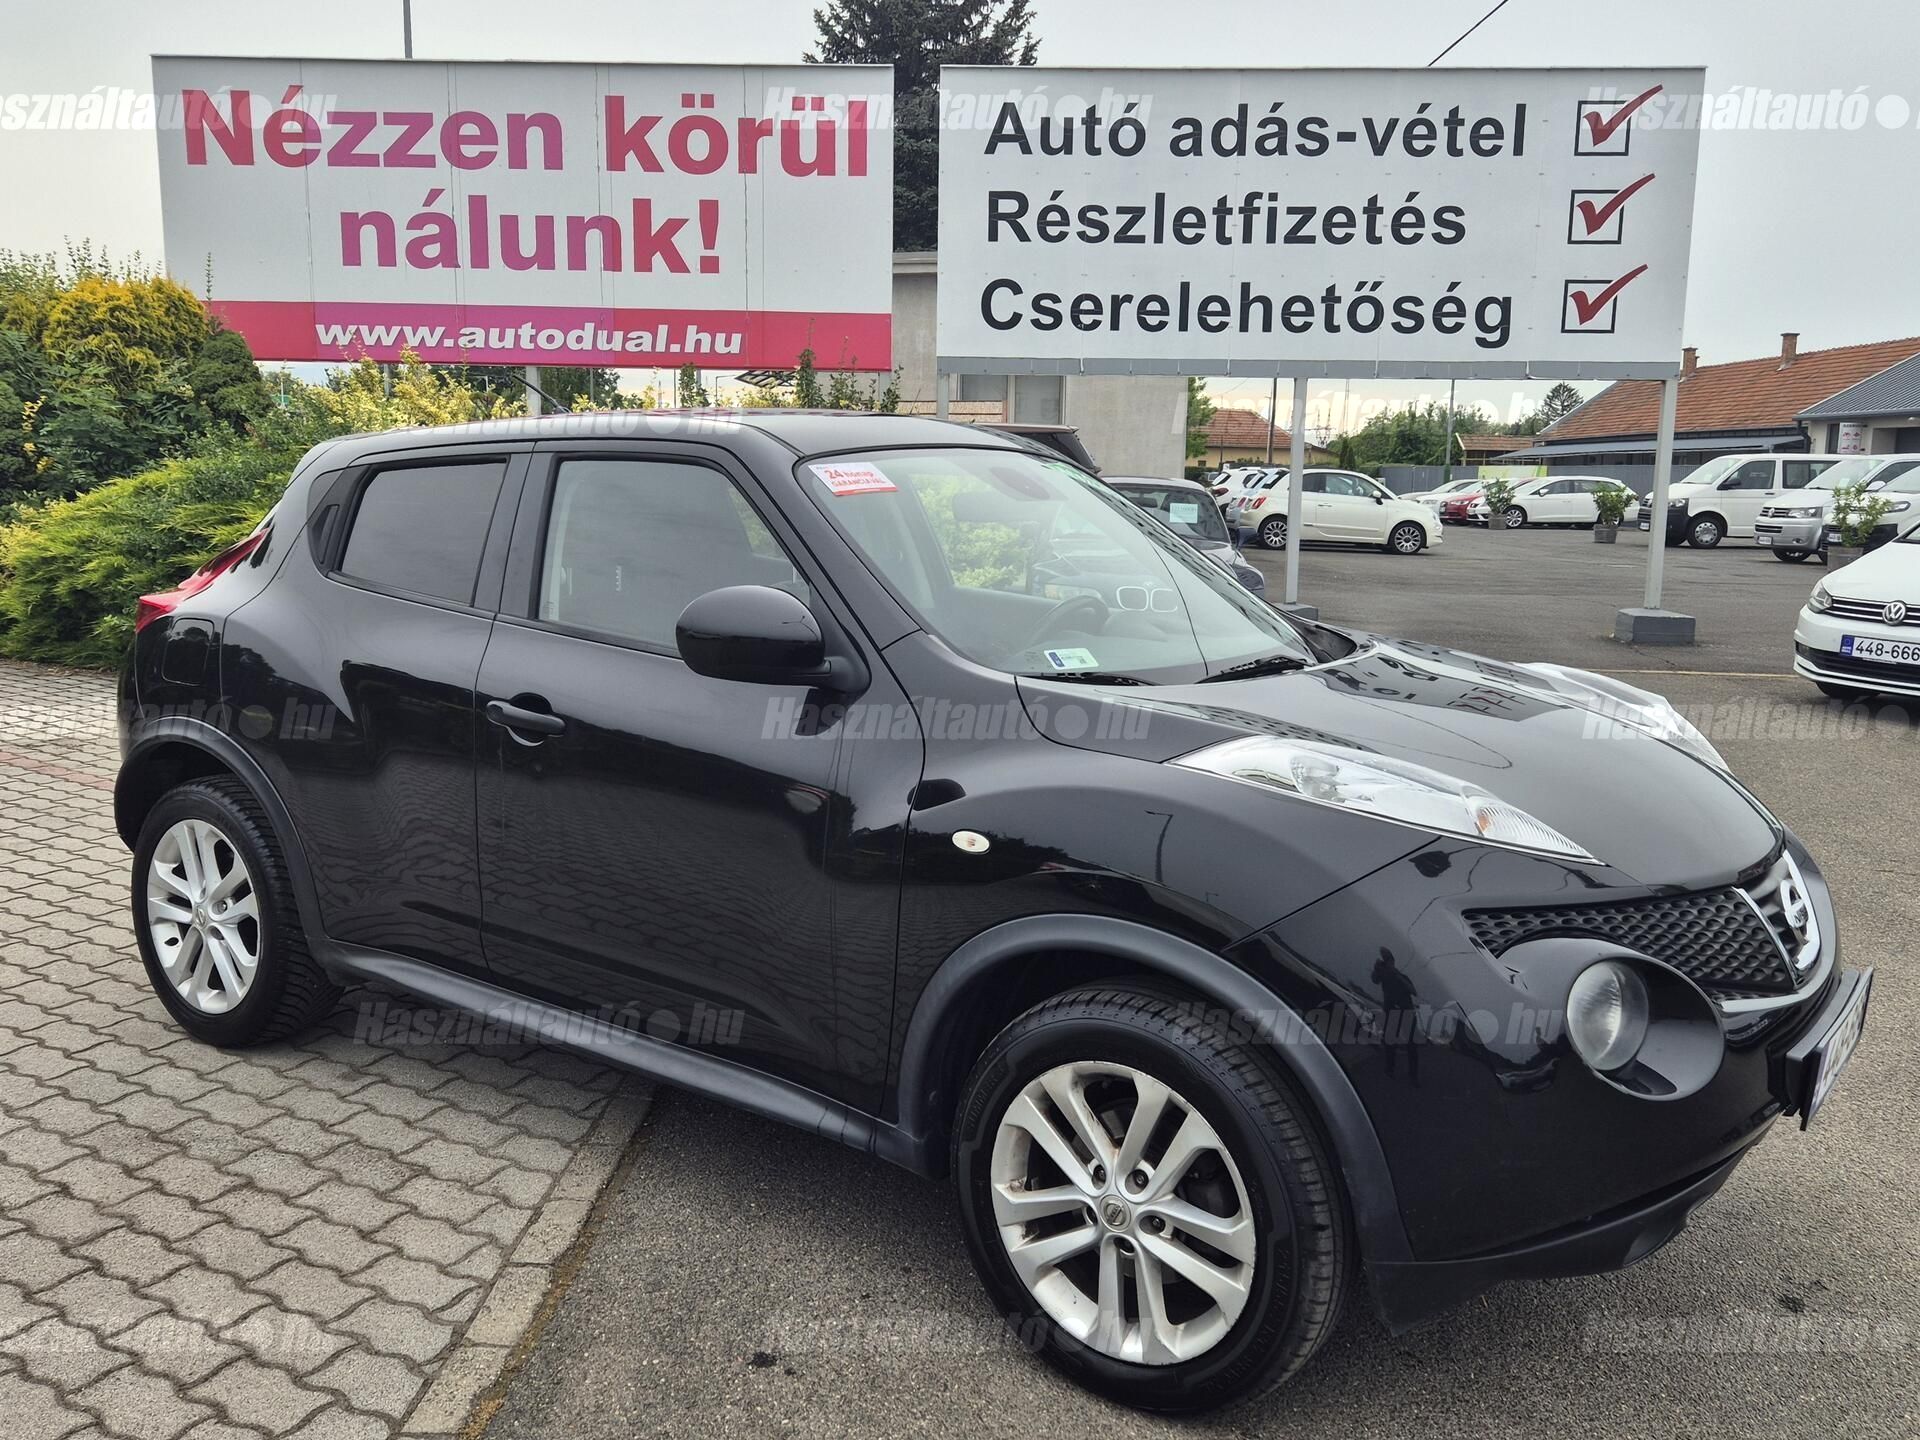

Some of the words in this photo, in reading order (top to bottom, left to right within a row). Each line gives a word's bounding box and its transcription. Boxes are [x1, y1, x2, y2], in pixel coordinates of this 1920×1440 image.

[181, 84, 563, 171] Nézzen
[604, 92, 868, 178] körül
[983, 101, 1147, 157] Autó
[1168, 101, 1527, 158] adás-vétel
[340, 187, 720, 274] nálunk!
[987, 189, 1467, 246] Részletfizetés
[315, 321, 743, 355] www.autodual.hu
[980, 278, 1513, 349] Cserelehetőség
[1855, 640, 1920, 662] 448-666
